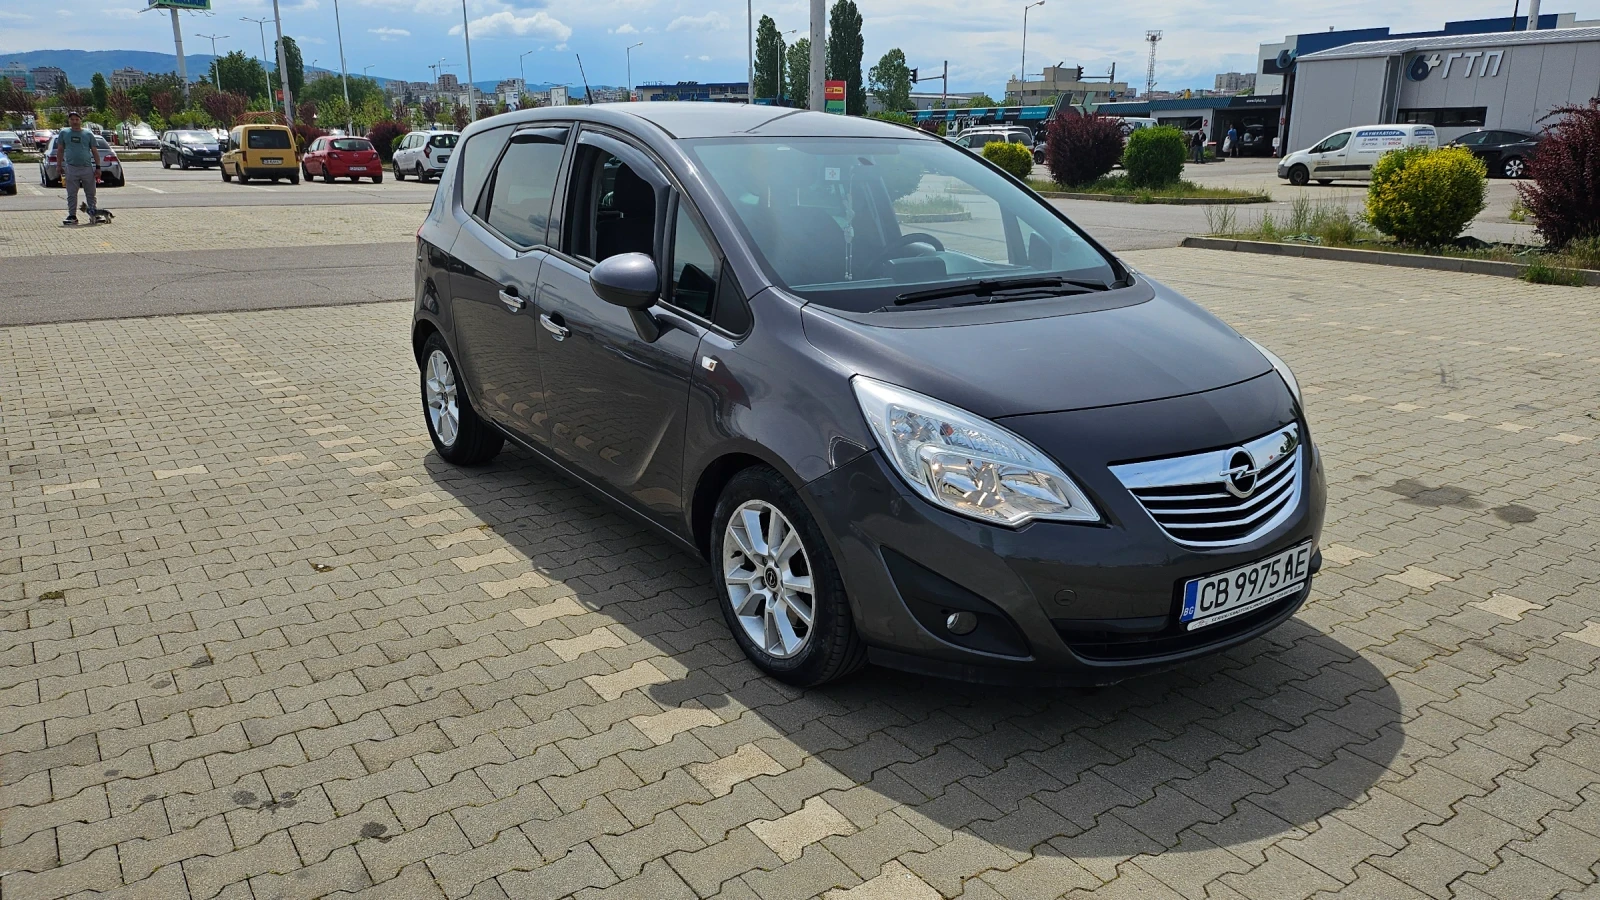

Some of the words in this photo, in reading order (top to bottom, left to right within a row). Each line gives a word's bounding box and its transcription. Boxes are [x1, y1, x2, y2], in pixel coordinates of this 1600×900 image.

[1442, 49, 1505, 79] ГТП
[1203, 119, 1208, 127] 2
[1280, 117, 1286, 126] 3
[1200, 577, 1229, 612] CB
[1235, 557, 1281, 602] 9975
[1283, 548, 1308, 584] AE
[1183, 606, 1195, 616] BG
